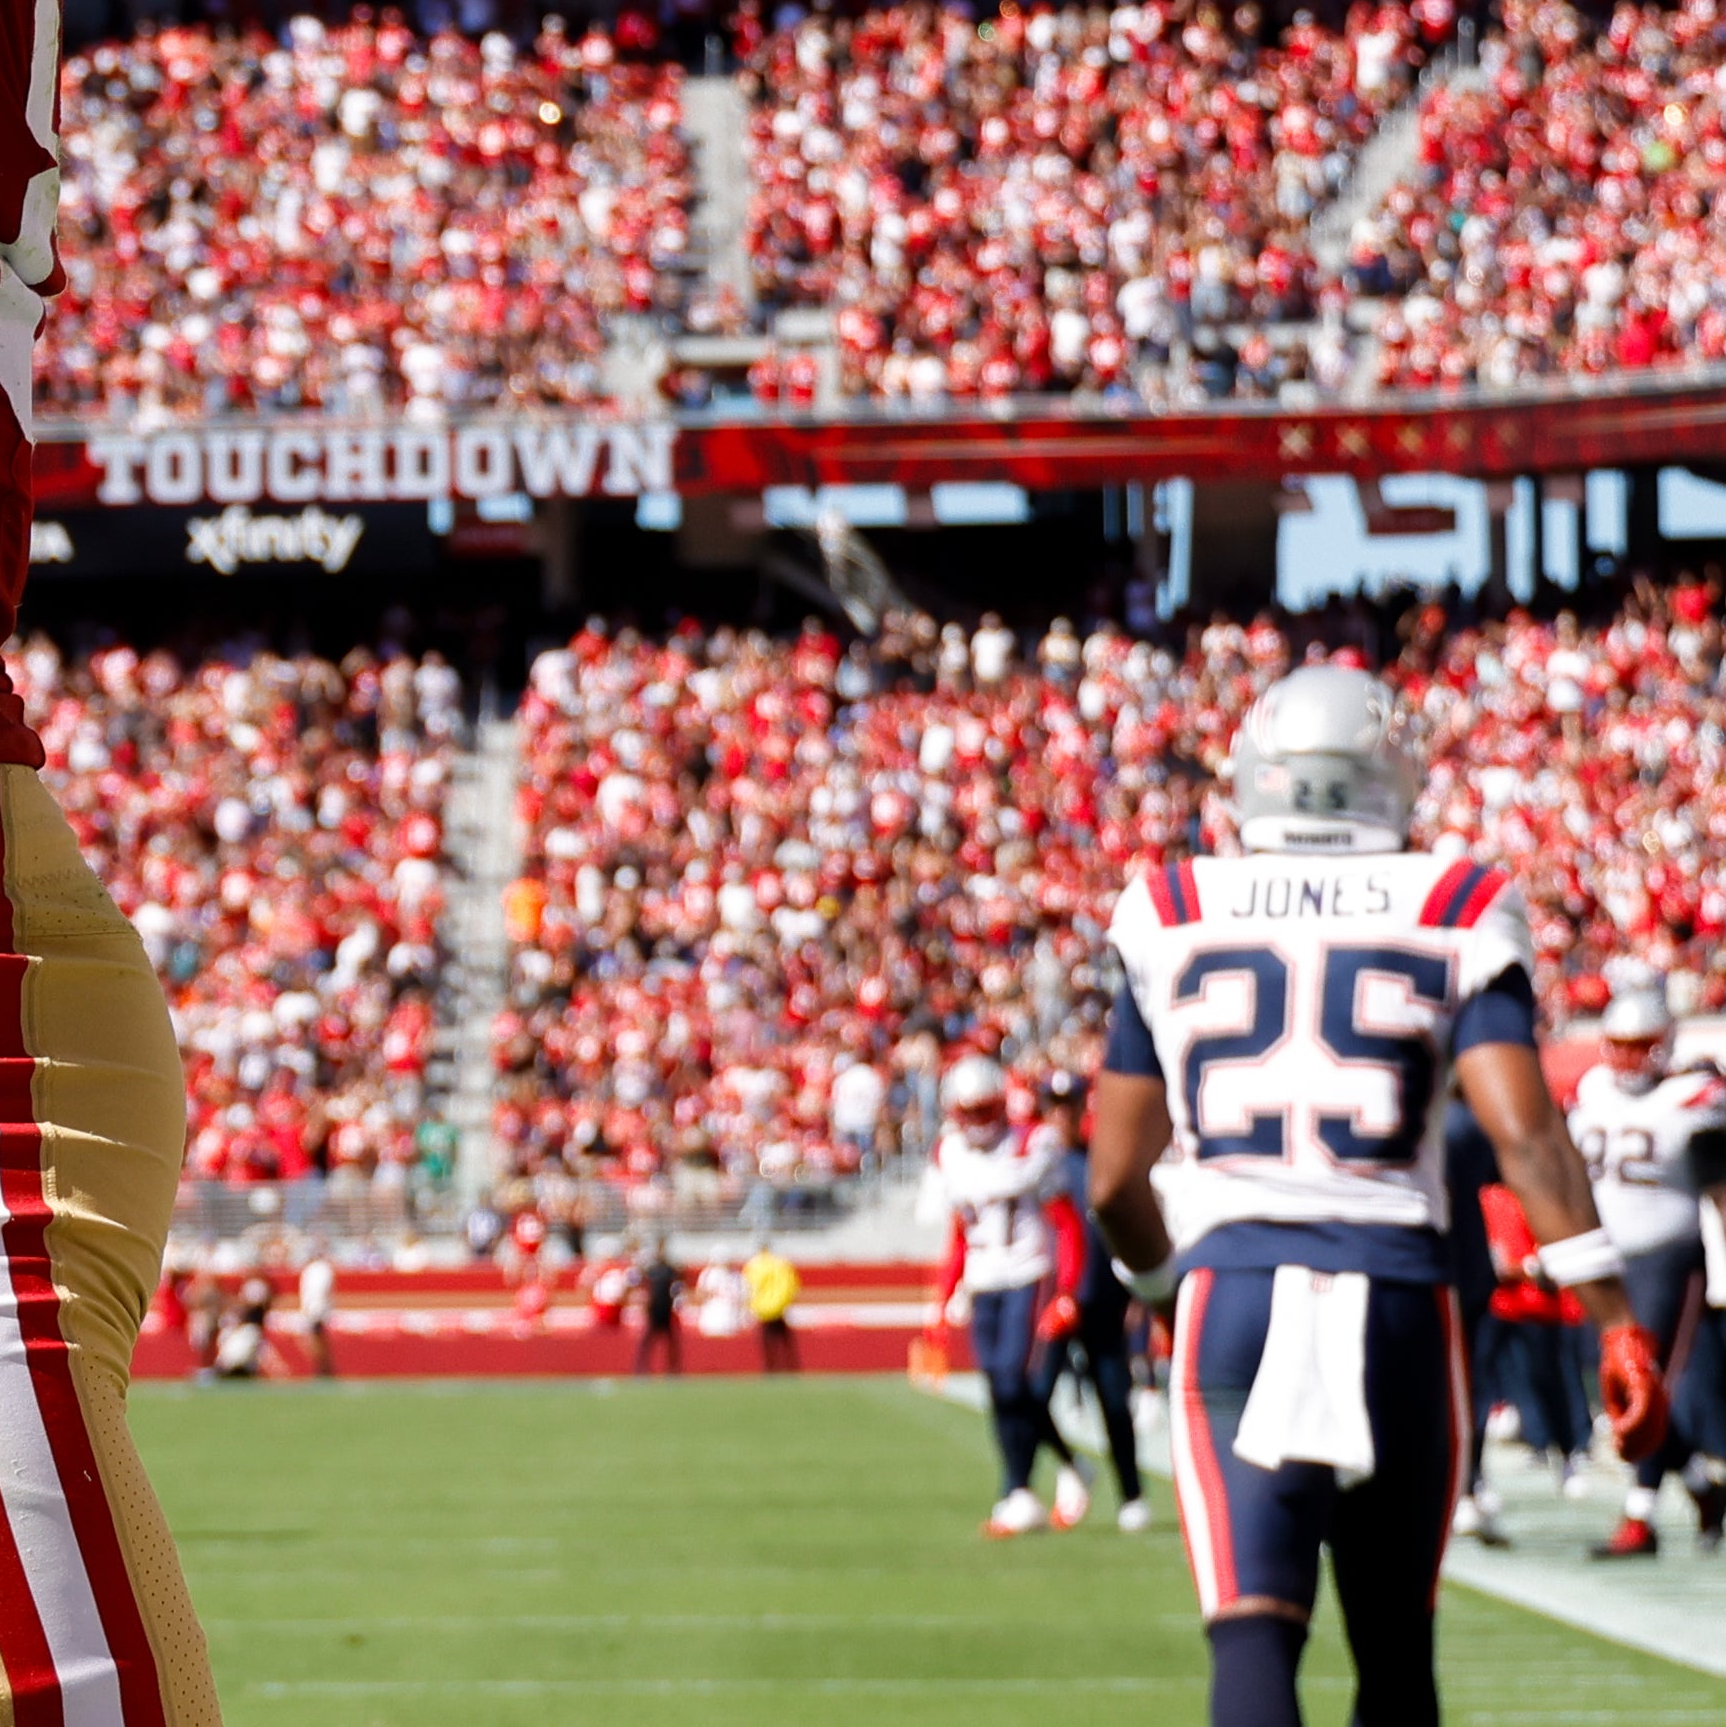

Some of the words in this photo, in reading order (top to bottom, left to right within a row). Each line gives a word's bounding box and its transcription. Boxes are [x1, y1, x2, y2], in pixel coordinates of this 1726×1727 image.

[86, 423, 678, 505] TOUCHDOWN
[186, 503, 364, 575] xfinity
[1231, 871, 1392, 918] JONES
[1170, 942, 1460, 1171] 25
